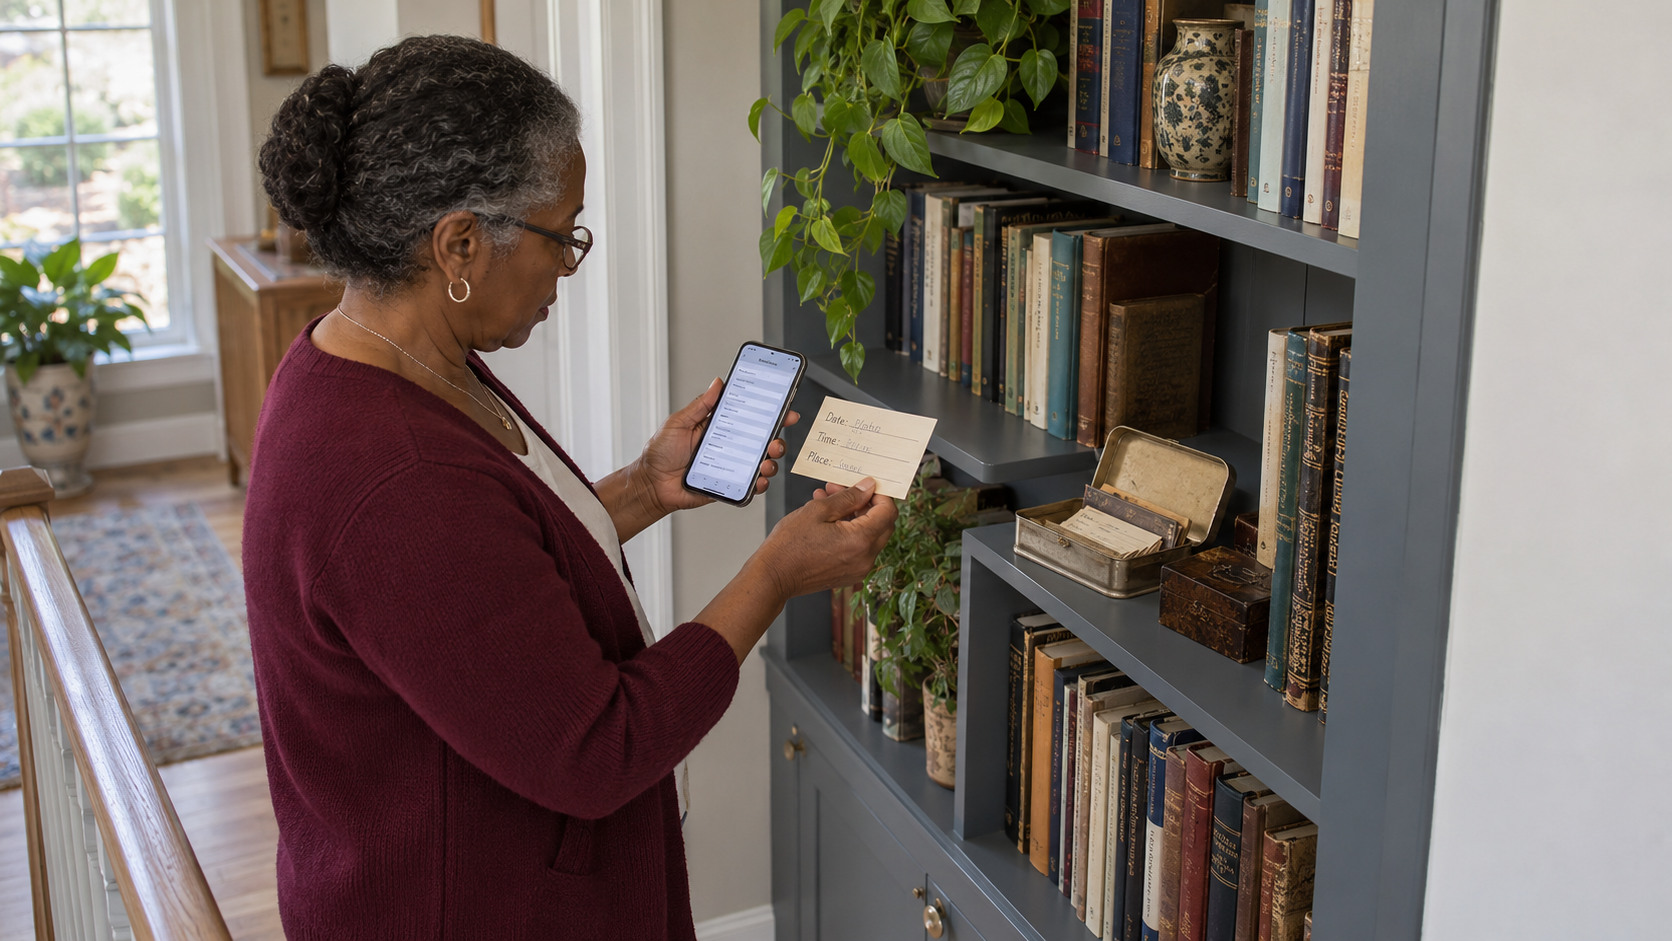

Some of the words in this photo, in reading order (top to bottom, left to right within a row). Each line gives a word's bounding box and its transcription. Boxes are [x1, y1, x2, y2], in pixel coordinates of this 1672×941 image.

[825, 411, 848, 426] Date:
[817, 431, 840, 446] Time:
[807, 451, 833, 466] Place:
